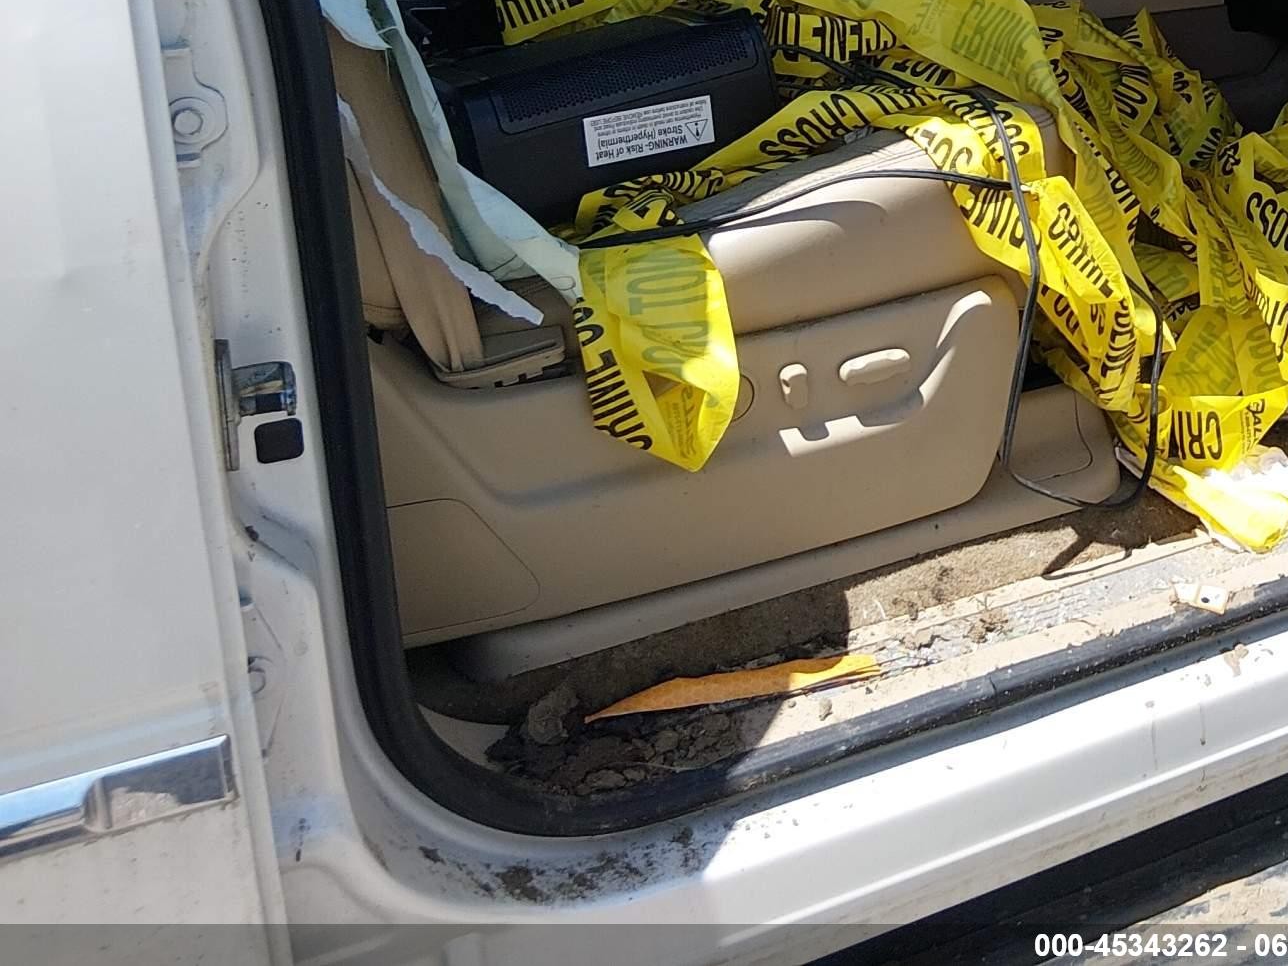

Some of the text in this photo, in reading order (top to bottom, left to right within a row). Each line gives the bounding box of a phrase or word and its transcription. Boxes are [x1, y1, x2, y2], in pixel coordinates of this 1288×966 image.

[657, 124, 683, 137] Stroke
[758, 93, 872, 157] CROSS
[597, 128, 656, 149] (Hyperthermia)
[595, 147, 614, 161] Heat
[614, 145, 625, 157] of
[625, 143, 644, 154] Risk
[959, 183, 1042, 255] RIME
